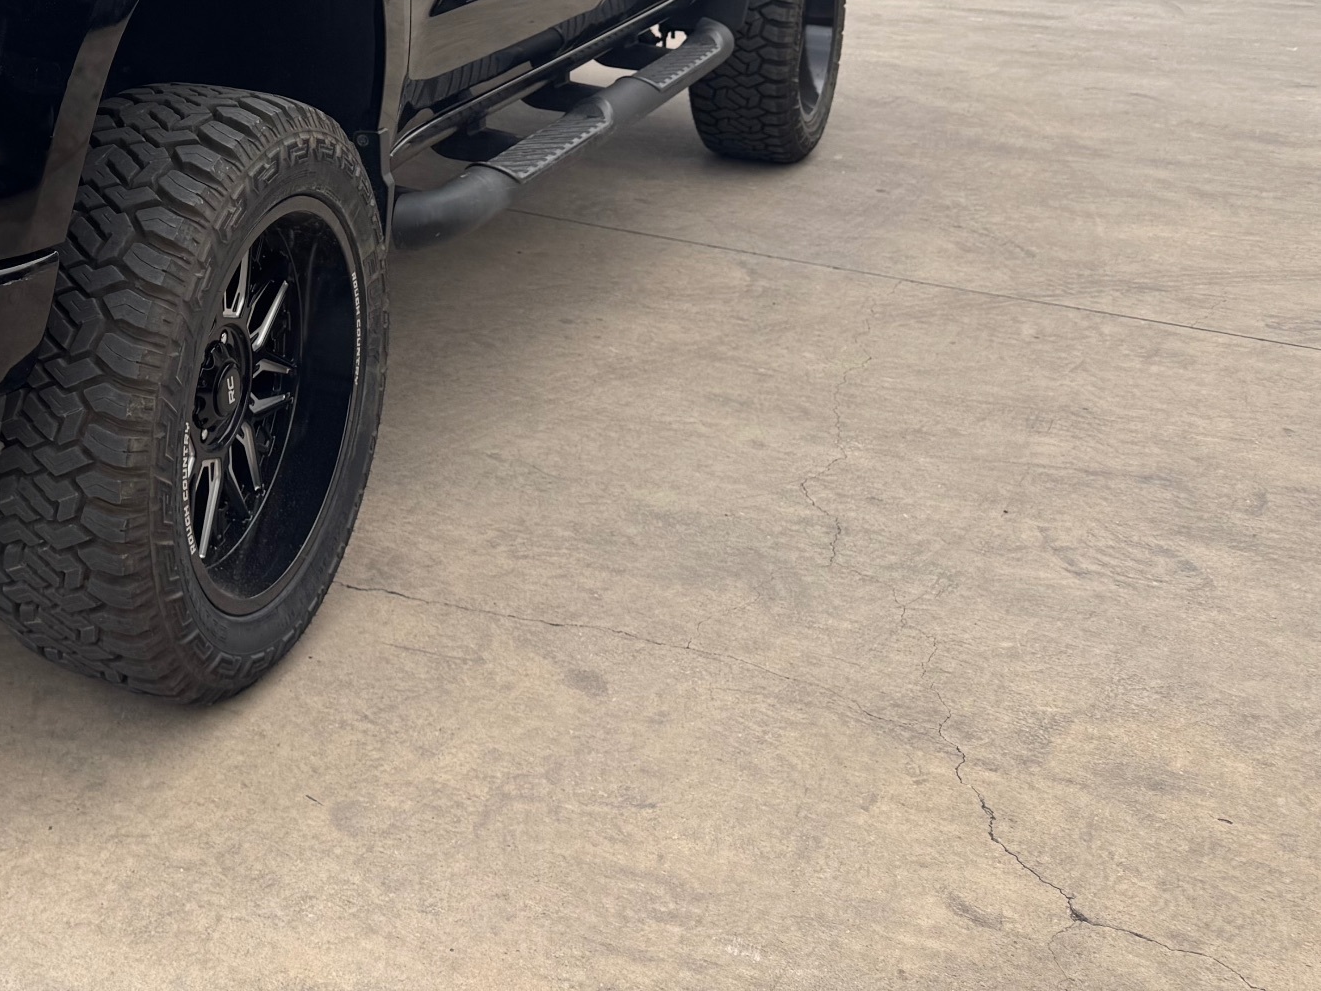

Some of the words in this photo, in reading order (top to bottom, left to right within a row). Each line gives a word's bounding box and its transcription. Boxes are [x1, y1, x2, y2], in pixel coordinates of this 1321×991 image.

[351, 272, 360, 316] ROUGH
[226, 376, 236, 405] RC
[182, 422, 190, 502] COUNTRY
[183, 507, 197, 556] ROUGH
